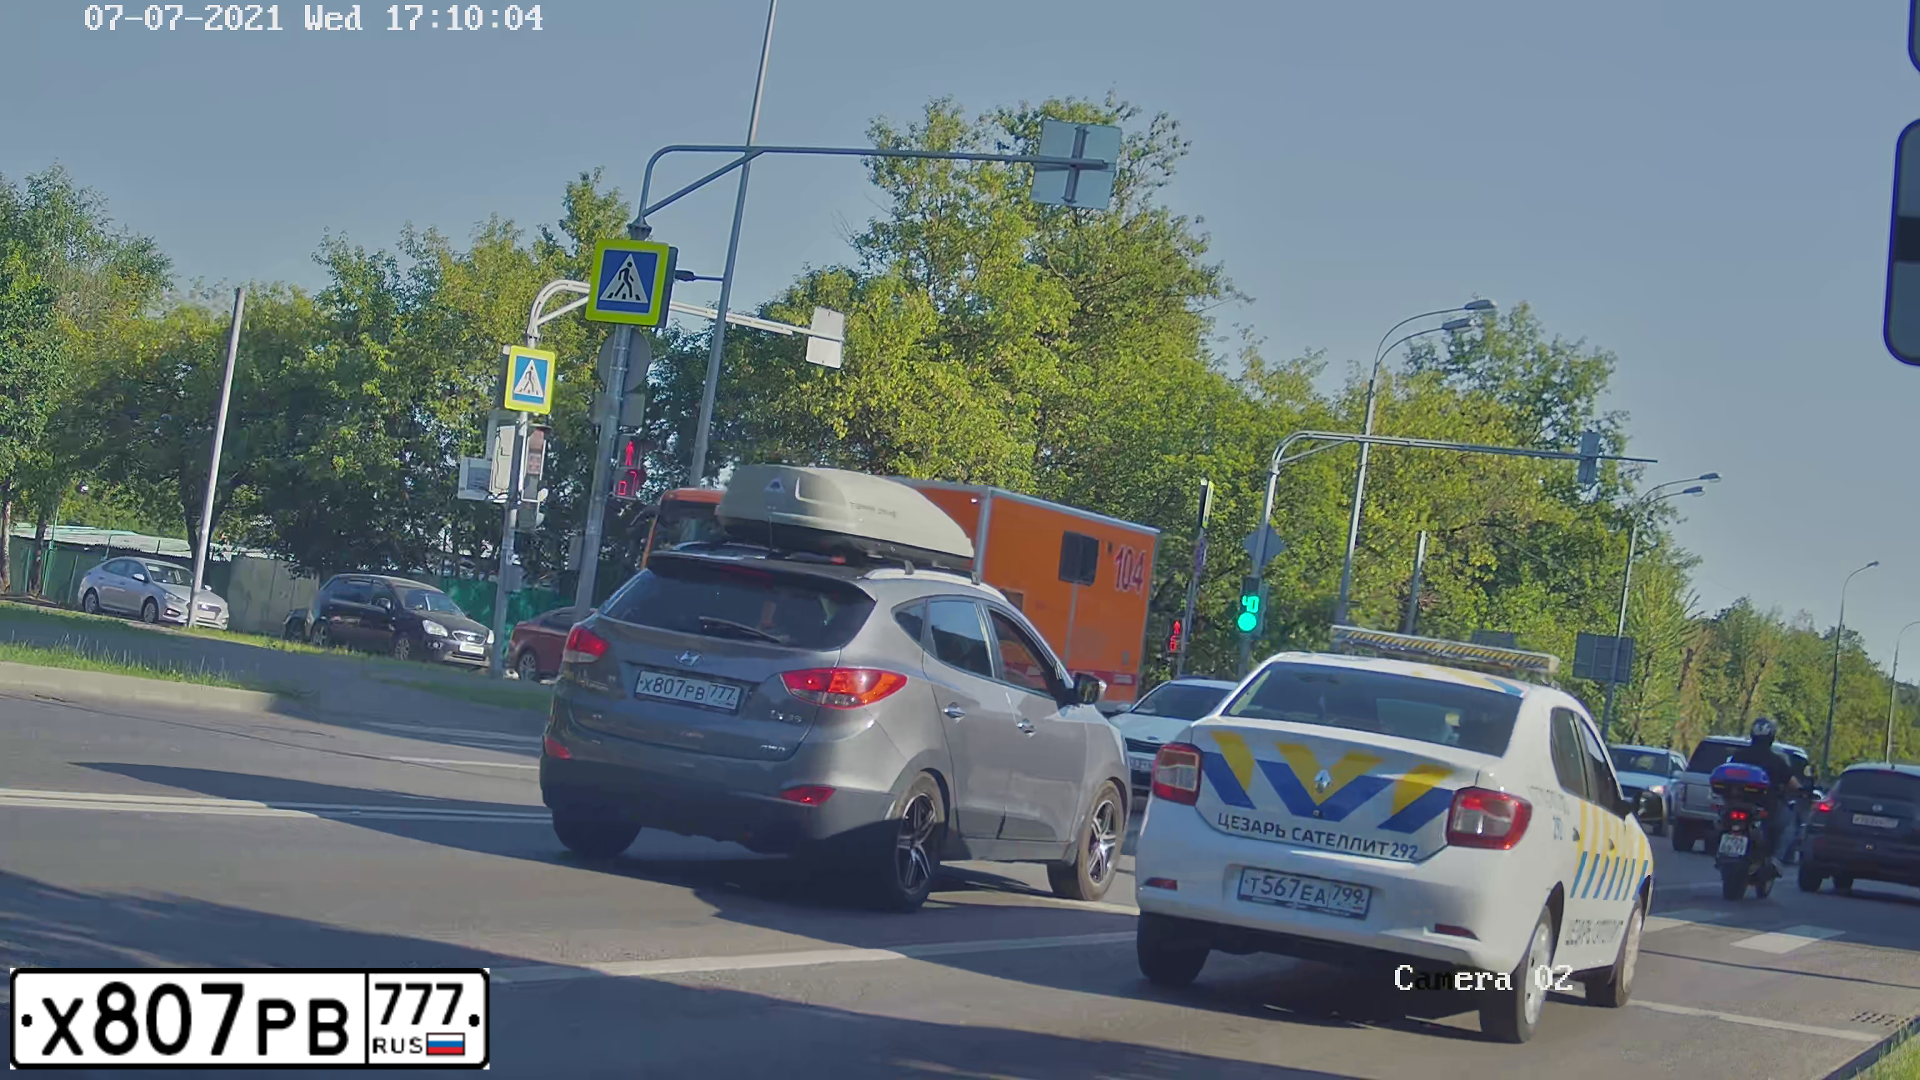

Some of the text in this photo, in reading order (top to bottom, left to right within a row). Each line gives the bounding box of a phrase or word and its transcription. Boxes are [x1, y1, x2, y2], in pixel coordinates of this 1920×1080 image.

[1114, 545, 1146, 594] 104
[1218, 812, 1418, 860] ЦЕЗАРЬ САТЕЛЛИТ 292
